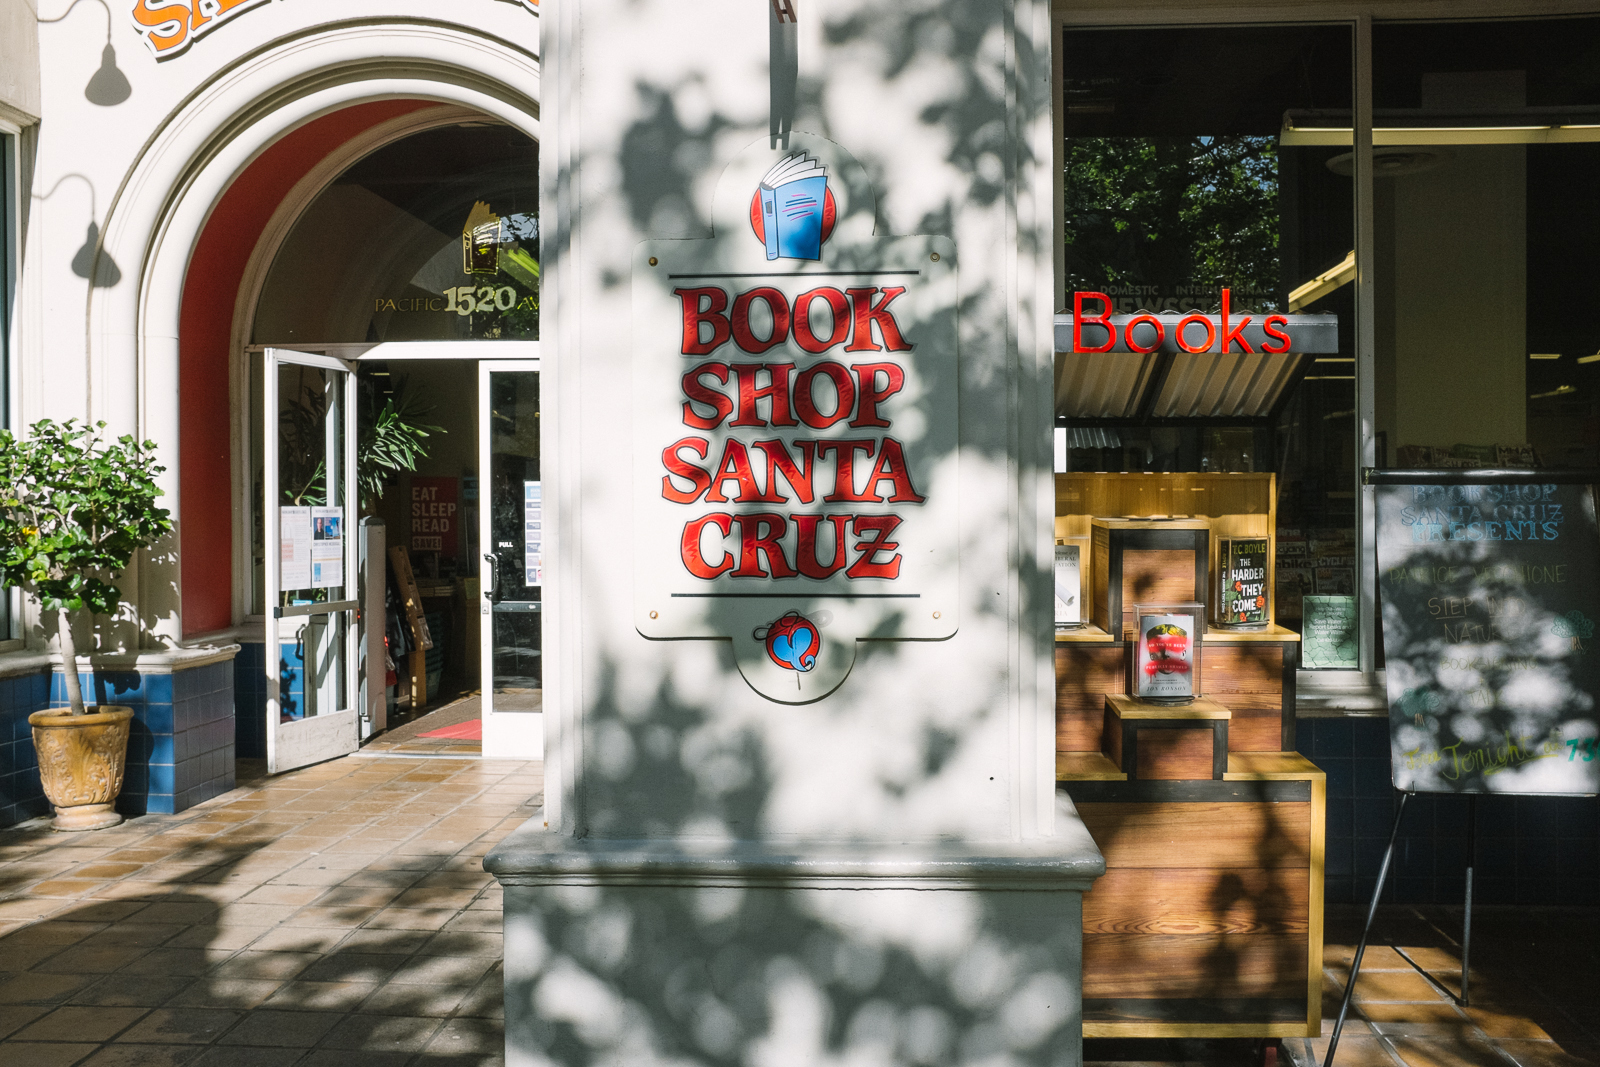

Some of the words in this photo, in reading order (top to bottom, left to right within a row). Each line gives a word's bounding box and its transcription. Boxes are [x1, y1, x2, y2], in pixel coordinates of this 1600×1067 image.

[1100, 285, 1159, 295] DOMESTIC
[375, 298, 442, 312] PACIFIC
[442, 285, 517, 316] 1520
[674, 286, 914, 355] BOOK
[1074, 288, 1291, 354] Books
[681, 362, 905, 430] SHOP
[661, 436, 927, 504] SANTA
[412, 486, 438, 501] EAT
[411, 502, 457, 517] SLEEP
[1400, 505, 1483, 526] SANTA
[1493, 504, 1564, 524] CRUZ
[412, 518, 450, 533] READ
[1411, 520, 1559, 541] PRESENTS
[413, 537, 442, 549] SAVE!
[498, 541, 515, 549] PULL
[680, 512, 904, 580] CRUZ
[1244, 543, 1266, 554] BOYLE
[1239, 558, 1251, 567] THE
[1231, 568, 1264, 581] HARDER
[1241, 583, 1264, 597] THEY
[1232, 598, 1257, 613] COME
[1428, 597, 1474, 616] STEP
[1440, 729, 1536, 781] Tonight
